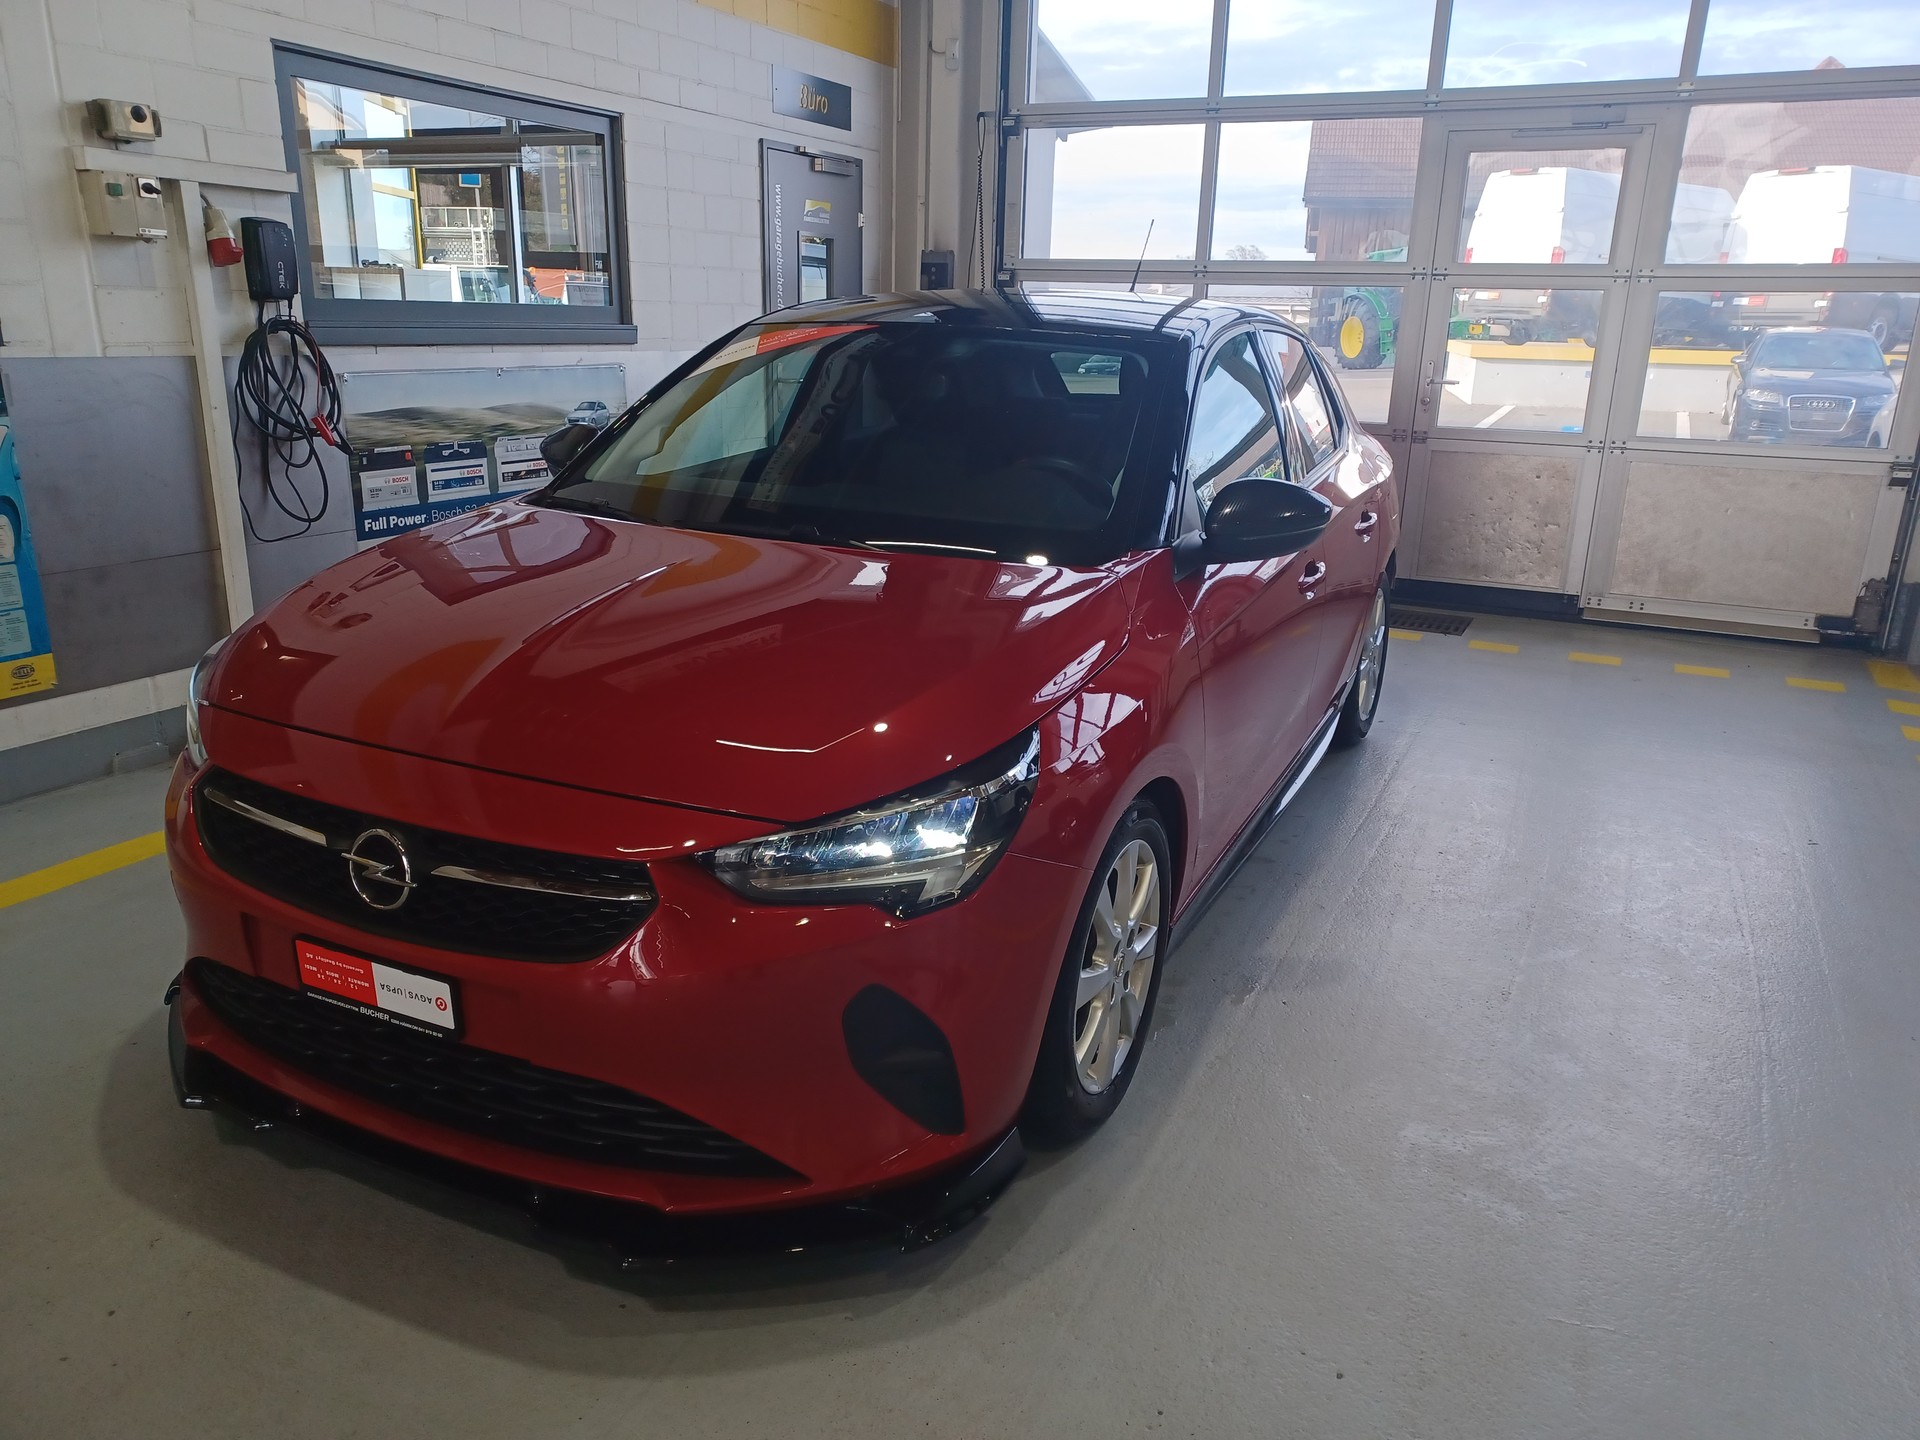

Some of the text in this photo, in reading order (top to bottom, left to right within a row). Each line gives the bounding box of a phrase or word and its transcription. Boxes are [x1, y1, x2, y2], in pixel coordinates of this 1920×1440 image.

[800, 83, 828, 114] Büro
[774, 183, 785, 310] www.garagebucher.ch
[277, 261, 285, 289] CTEK
[392, 476, 409, 484] BOSCH
[364, 516, 388, 532] Full
[431, 507, 462, 522] Bosch
[12, 665, 35, 676] HELLA
[360, 1006, 390, 1022] BUCHER
